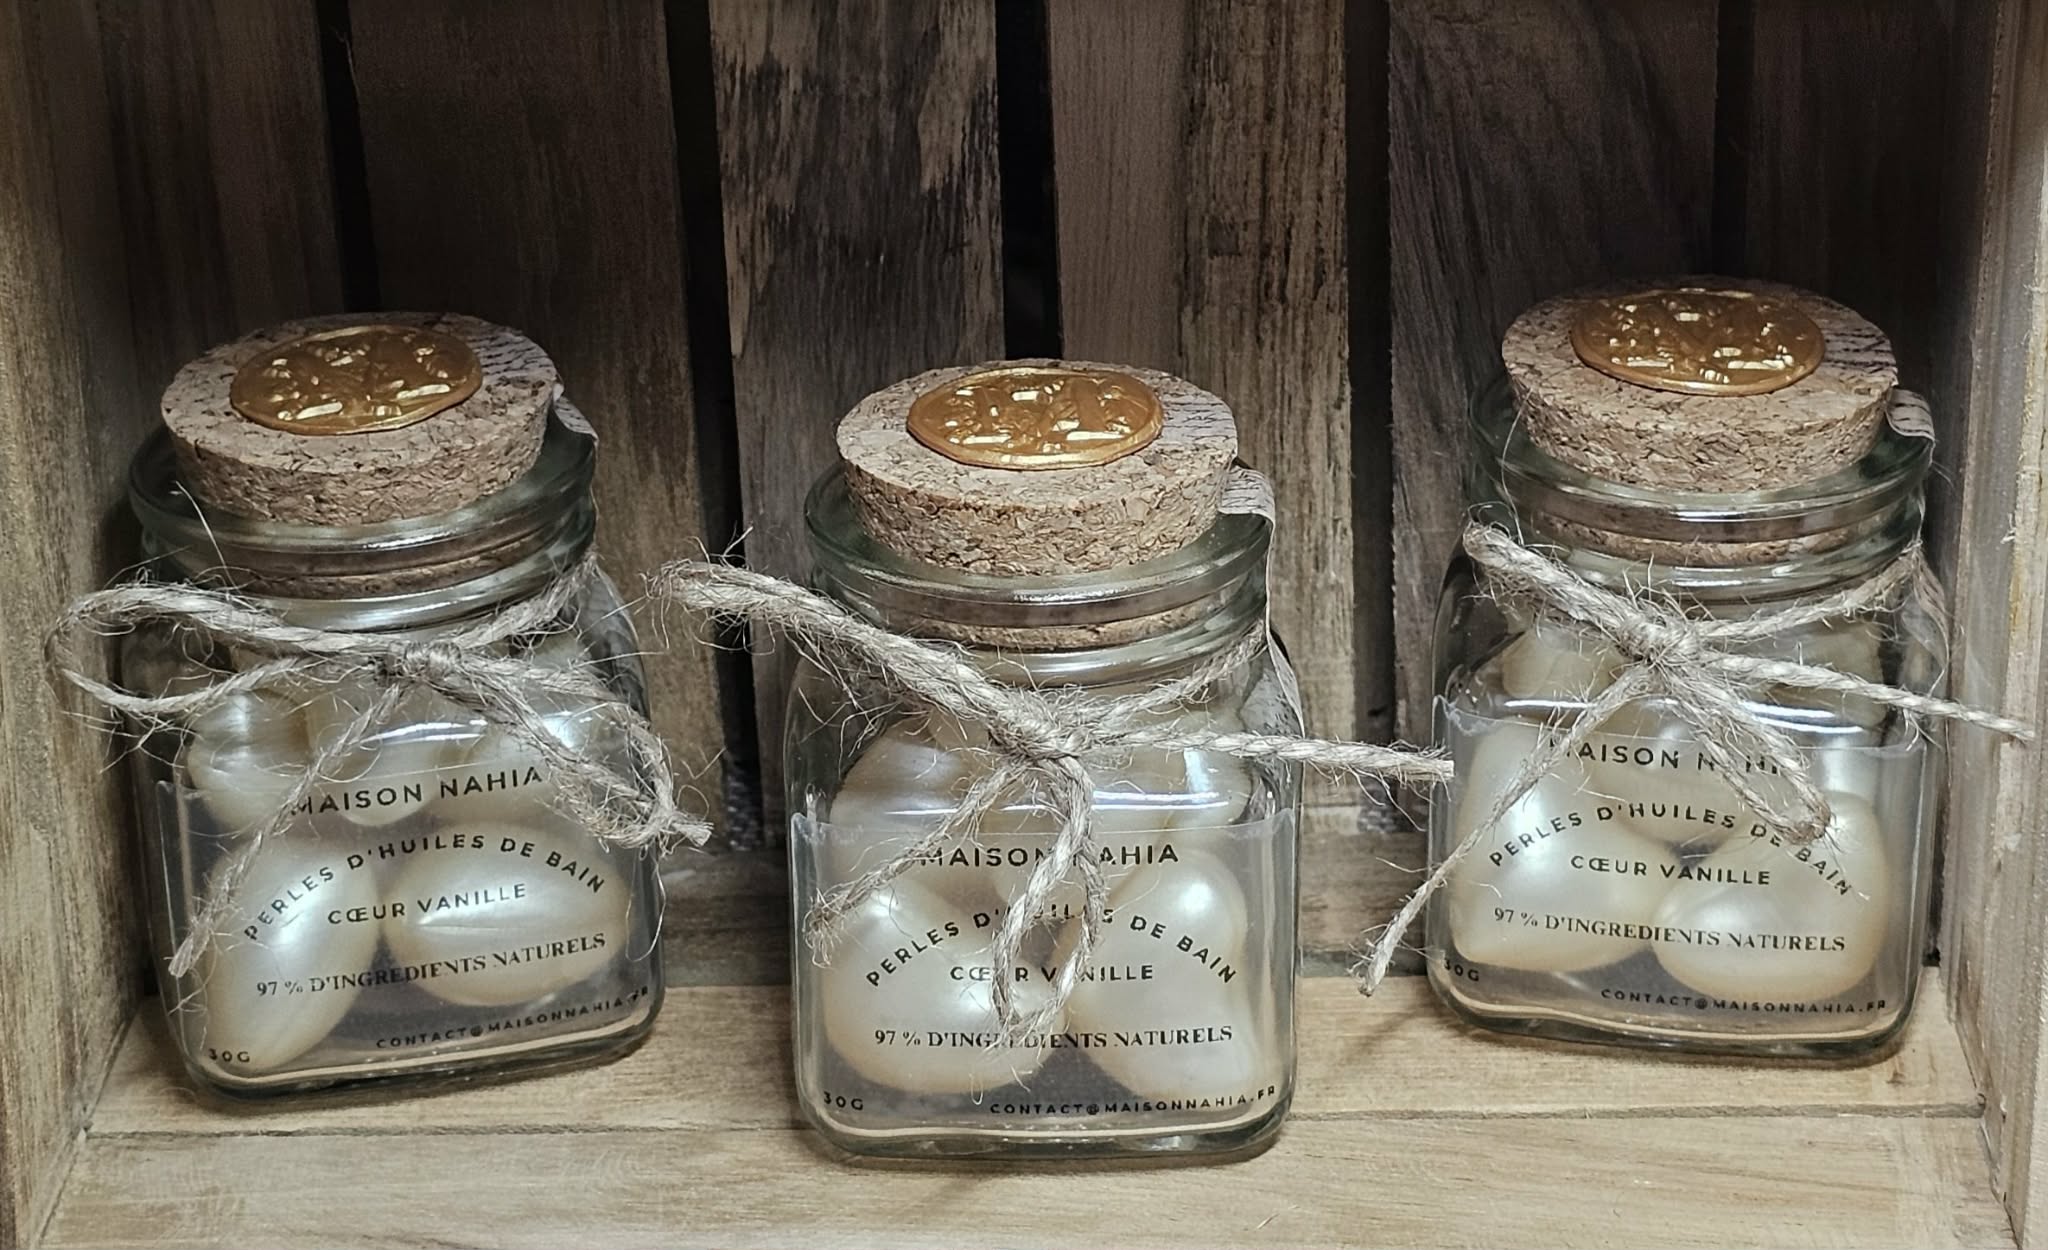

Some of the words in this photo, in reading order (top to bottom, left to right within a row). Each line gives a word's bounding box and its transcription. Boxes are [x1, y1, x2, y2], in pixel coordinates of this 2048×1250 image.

[440, 766, 543, 799] NAHIA
[1070, 844, 1179, 867] AHIA
[1489, 811, 1582, 867] PERLES
[1597, 803, 1735, 829] D'HUILES
[1751, 823, 1782, 848] DE
[1795, 847, 1851, 895] BAIN
[1570, 855, 1647, 877] CŒUR
[1660, 863, 1771, 885] VANILLE
[244, 866, 335, 941] PERLES
[346, 834, 485, 870] D'HUILES
[500, 837, 535, 858] DE
[546, 851, 605, 893] BAIN
[327, 901, 406, 925] CŒUR
[417, 882, 527, 914] VANILLE
[1494, 907, 1515, 924] 97
[1520, 911, 1539, 927] %
[1545, 915, 1720, 947] D'INGREDIENTS
[1727, 931, 1845, 952] NATURELS
[256, 980, 278, 997] 97
[283, 978, 304, 995] %
[309, 953, 487, 993] D'INGREDIENTS
[493, 932, 606, 969] NATURELS
[866, 921, 959, 987] PERLES
[1130, 915, 1166, 939] DE
[1176, 935, 1236, 983] BAIN
[950, 966, 1029, 982] CŒR
[1041, 965, 1153, 982] VNILLE
[1600, 987, 1886, 1014] CONTACT@MAISONNAHIA.FR
[875, 1028, 896, 1044] 97
[902, 1031, 921, 1046] %
[1114, 1026, 1233, 1048] NATURELS
[208, 1047, 251, 1064] 30G
[823, 1091, 864, 1111] 30G
[990, 1085, 1276, 1115] CONTACT@MAISONNAHIA.FR
